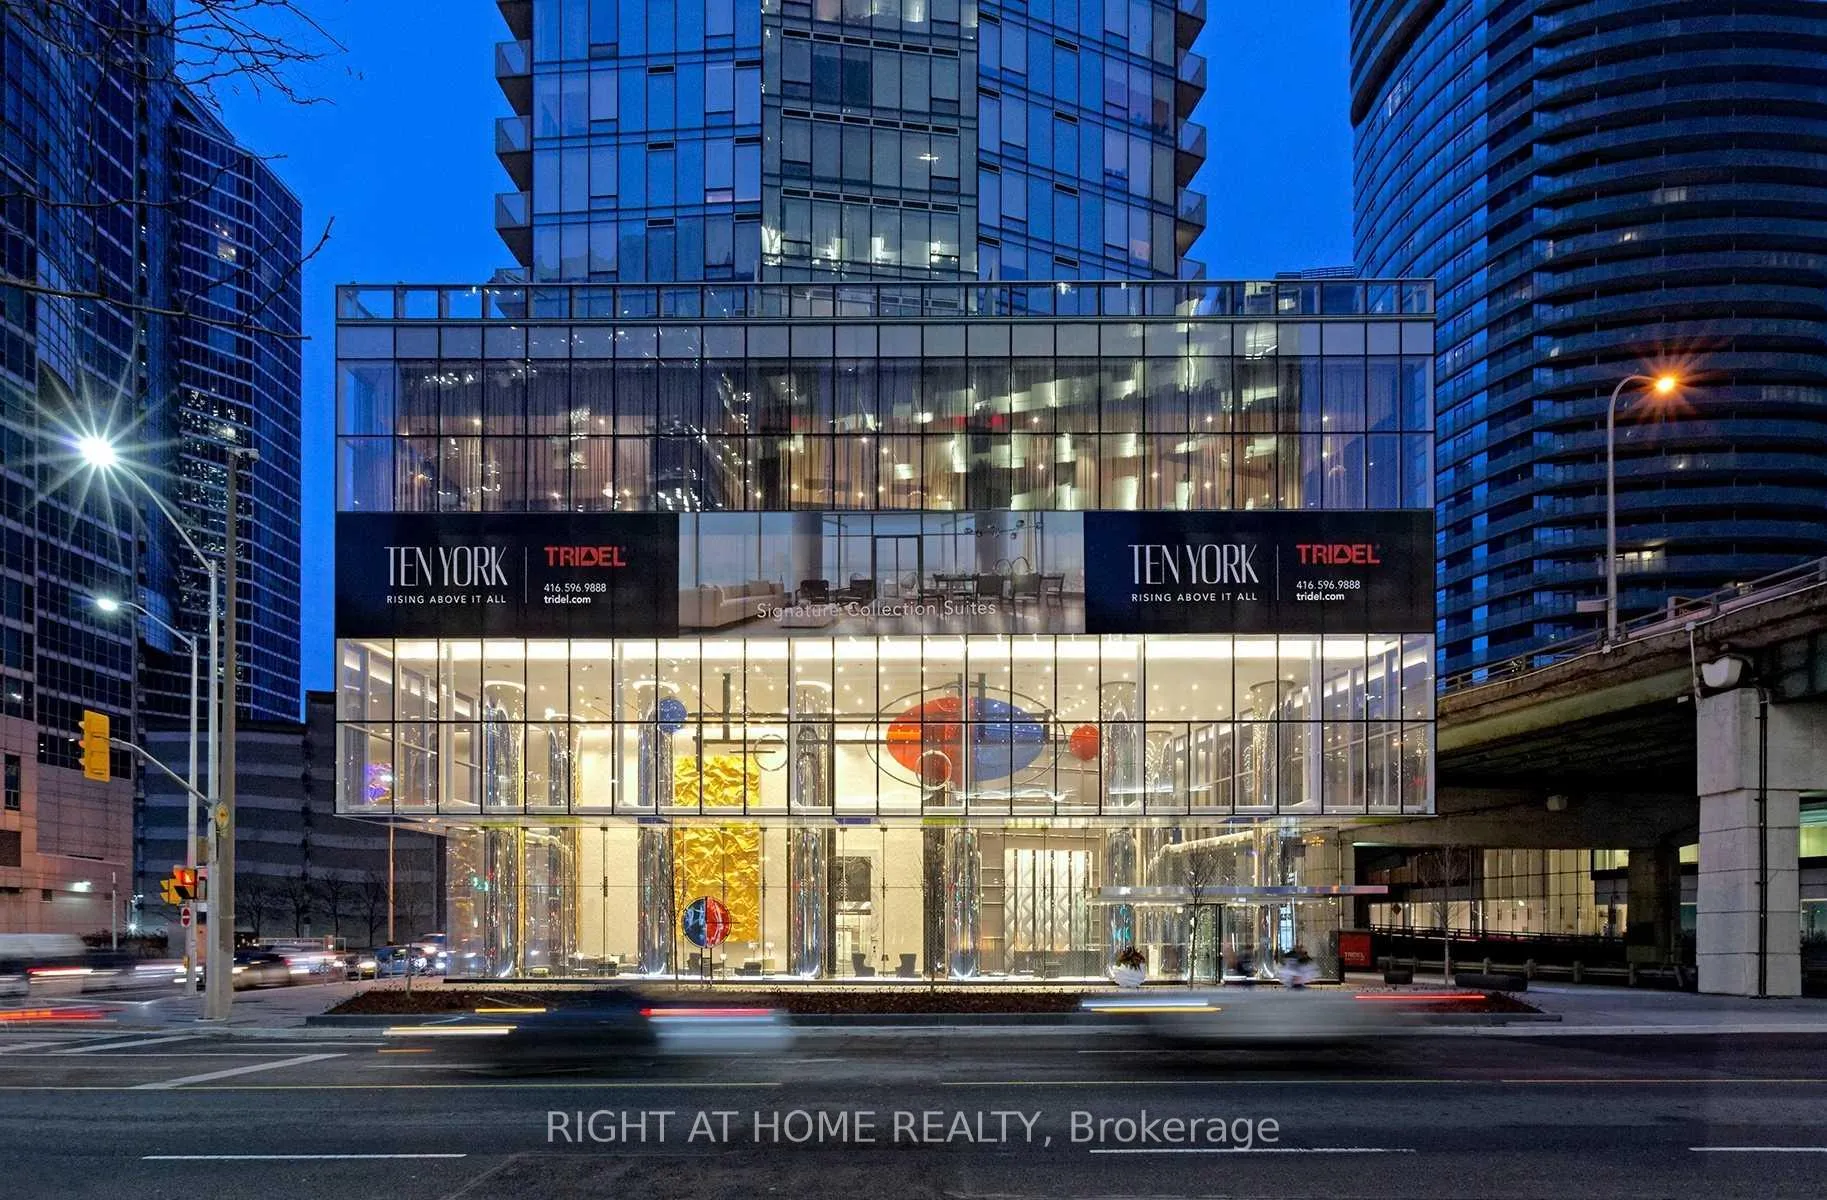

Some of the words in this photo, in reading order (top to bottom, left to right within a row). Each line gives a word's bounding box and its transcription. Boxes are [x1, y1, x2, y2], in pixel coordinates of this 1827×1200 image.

[544, 546, 626, 566] TRIDEL
[1296, 544, 1380, 564] TRIDEL
[384, 546, 432, 586] TEN
[439, 546, 508, 586] YORK
[1128, 544, 1179, 584] TEN
[1186, 544, 1259, 584] YORK
[543, 583, 607, 593] 416.596.9888
[1296, 580, 1361, 590] 416.596.9888
[386, 595, 425, 604] RISING
[429, 595, 467, 604] ABOVE
[471, 595, 482, 604] IT
[486, 595, 507, 604] ALL
[543, 595, 592, 604] tridel.com
[1131, 593, 1172, 602] RISING
[1177, 593, 1217, 602] ABOVE
[1221, 592, 1232, 601] IT
[1236, 592, 1258, 601] ALL
[1296, 591, 1346, 601] tridel.com
[756, 602, 840, 622] Signature
[847, 600, 937, 617] Collection
[943, 600, 997, 616] Suites
